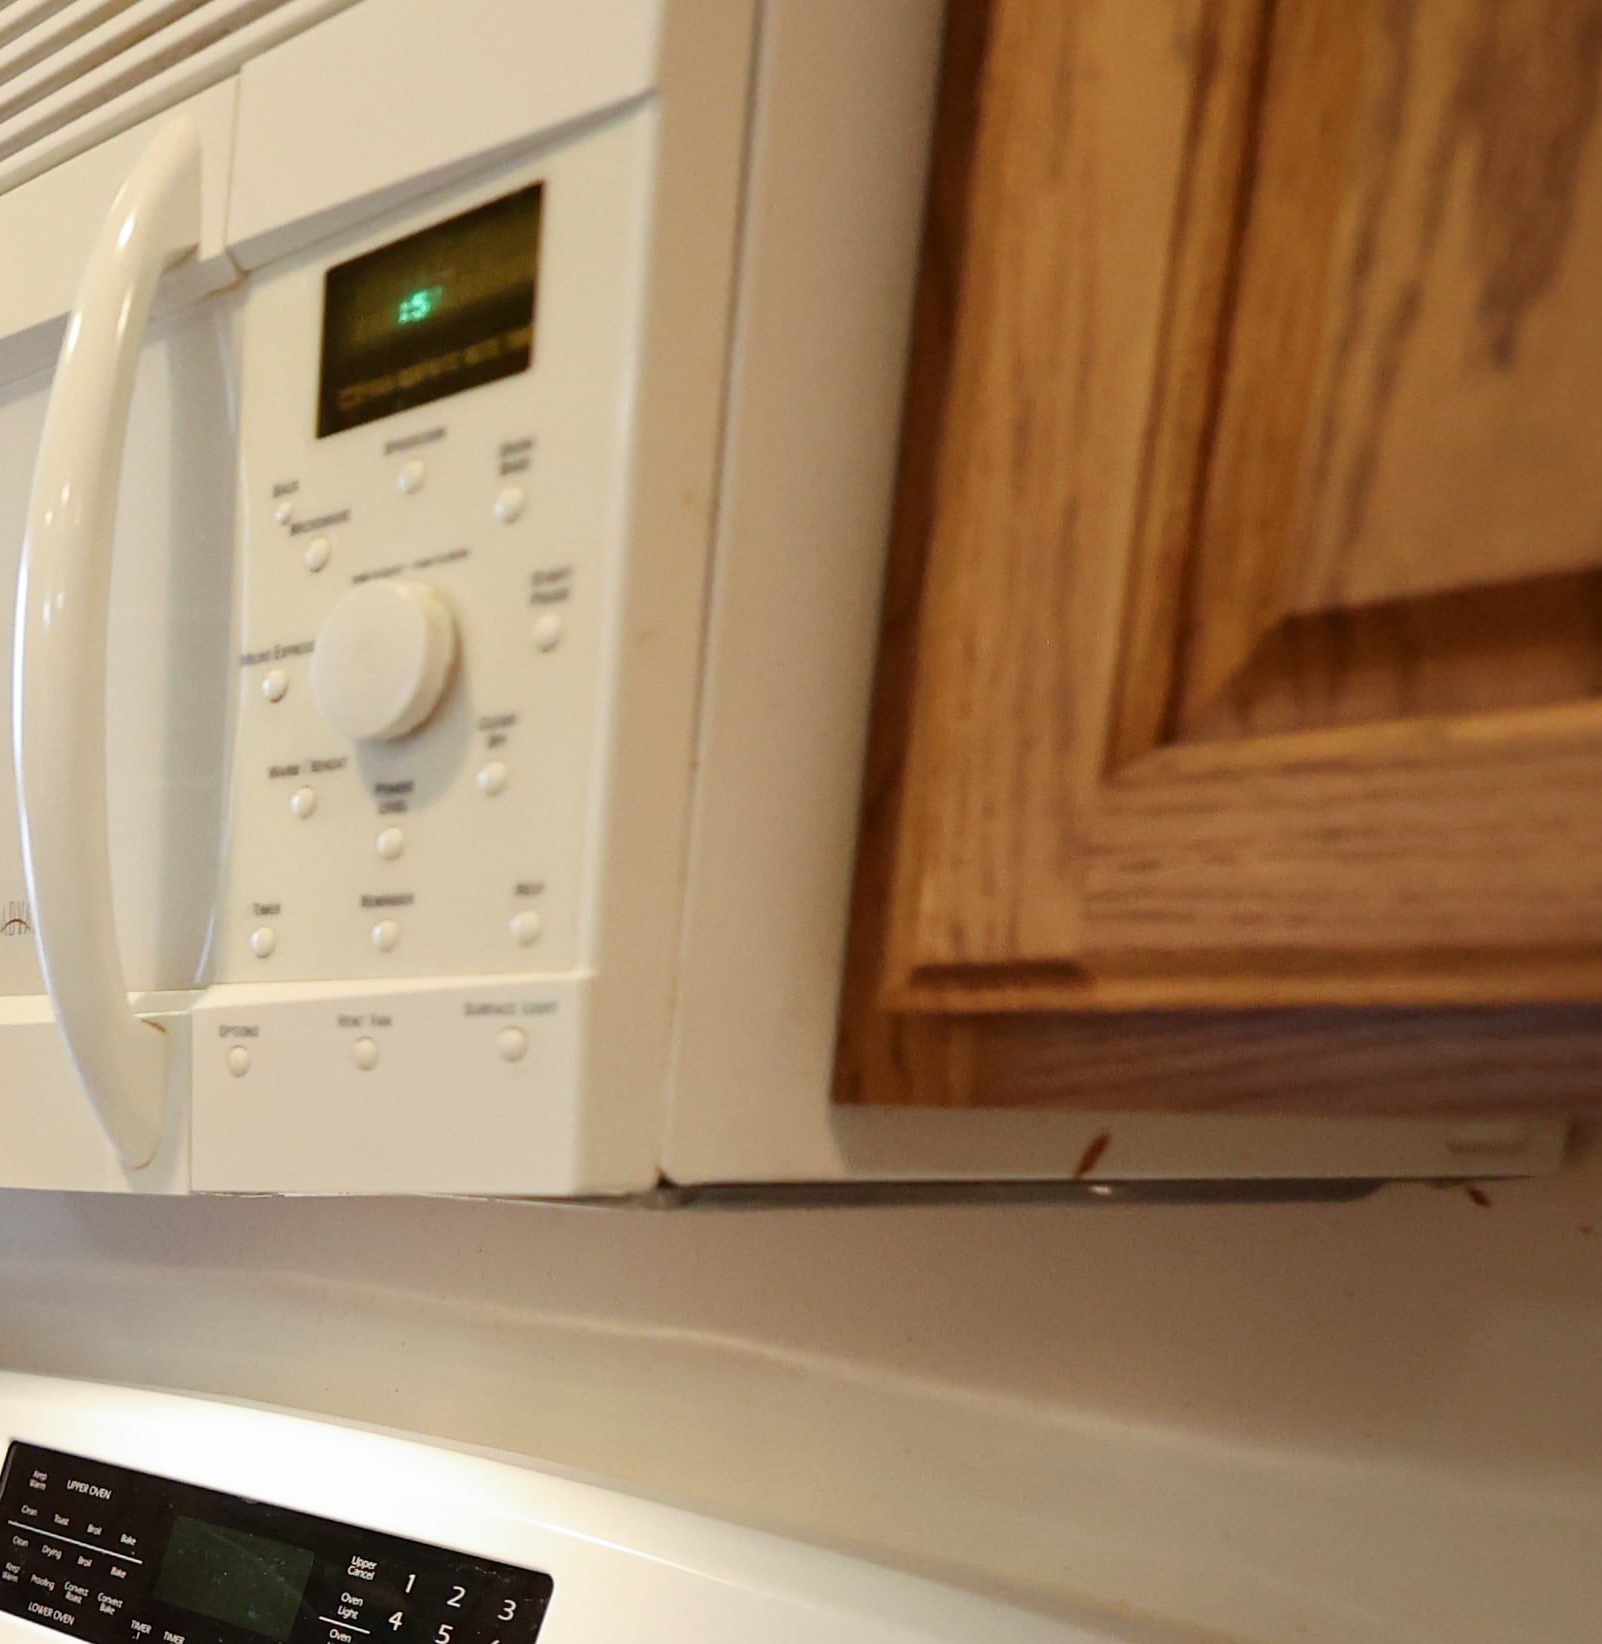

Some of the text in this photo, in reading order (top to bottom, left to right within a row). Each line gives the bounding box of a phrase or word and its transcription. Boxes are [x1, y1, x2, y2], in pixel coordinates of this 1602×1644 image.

[66, 1479, 113, 1500] UPPER OVEN
[120, 1533, 137, 1546] Bake
[351, 1555, 378, 1571] Upper
[347, 1565, 375, 1581] Cancel
[405, 1573, 416, 1594] 1
[340, 1592, 364, 1607] Oven
[447, 1585, 466, 1608] 2
[28, 1601, 75, 1626] LOWER OVEN
[337, 1605, 359, 1621] Light
[497, 1599, 517, 1621] 3
[131, 1619, 152, 1635] TIMER
[388, 1611, 404, 1631] 4
[329, 1628, 352, 1644] Oven
[435, 1624, 454, 1644] 5
